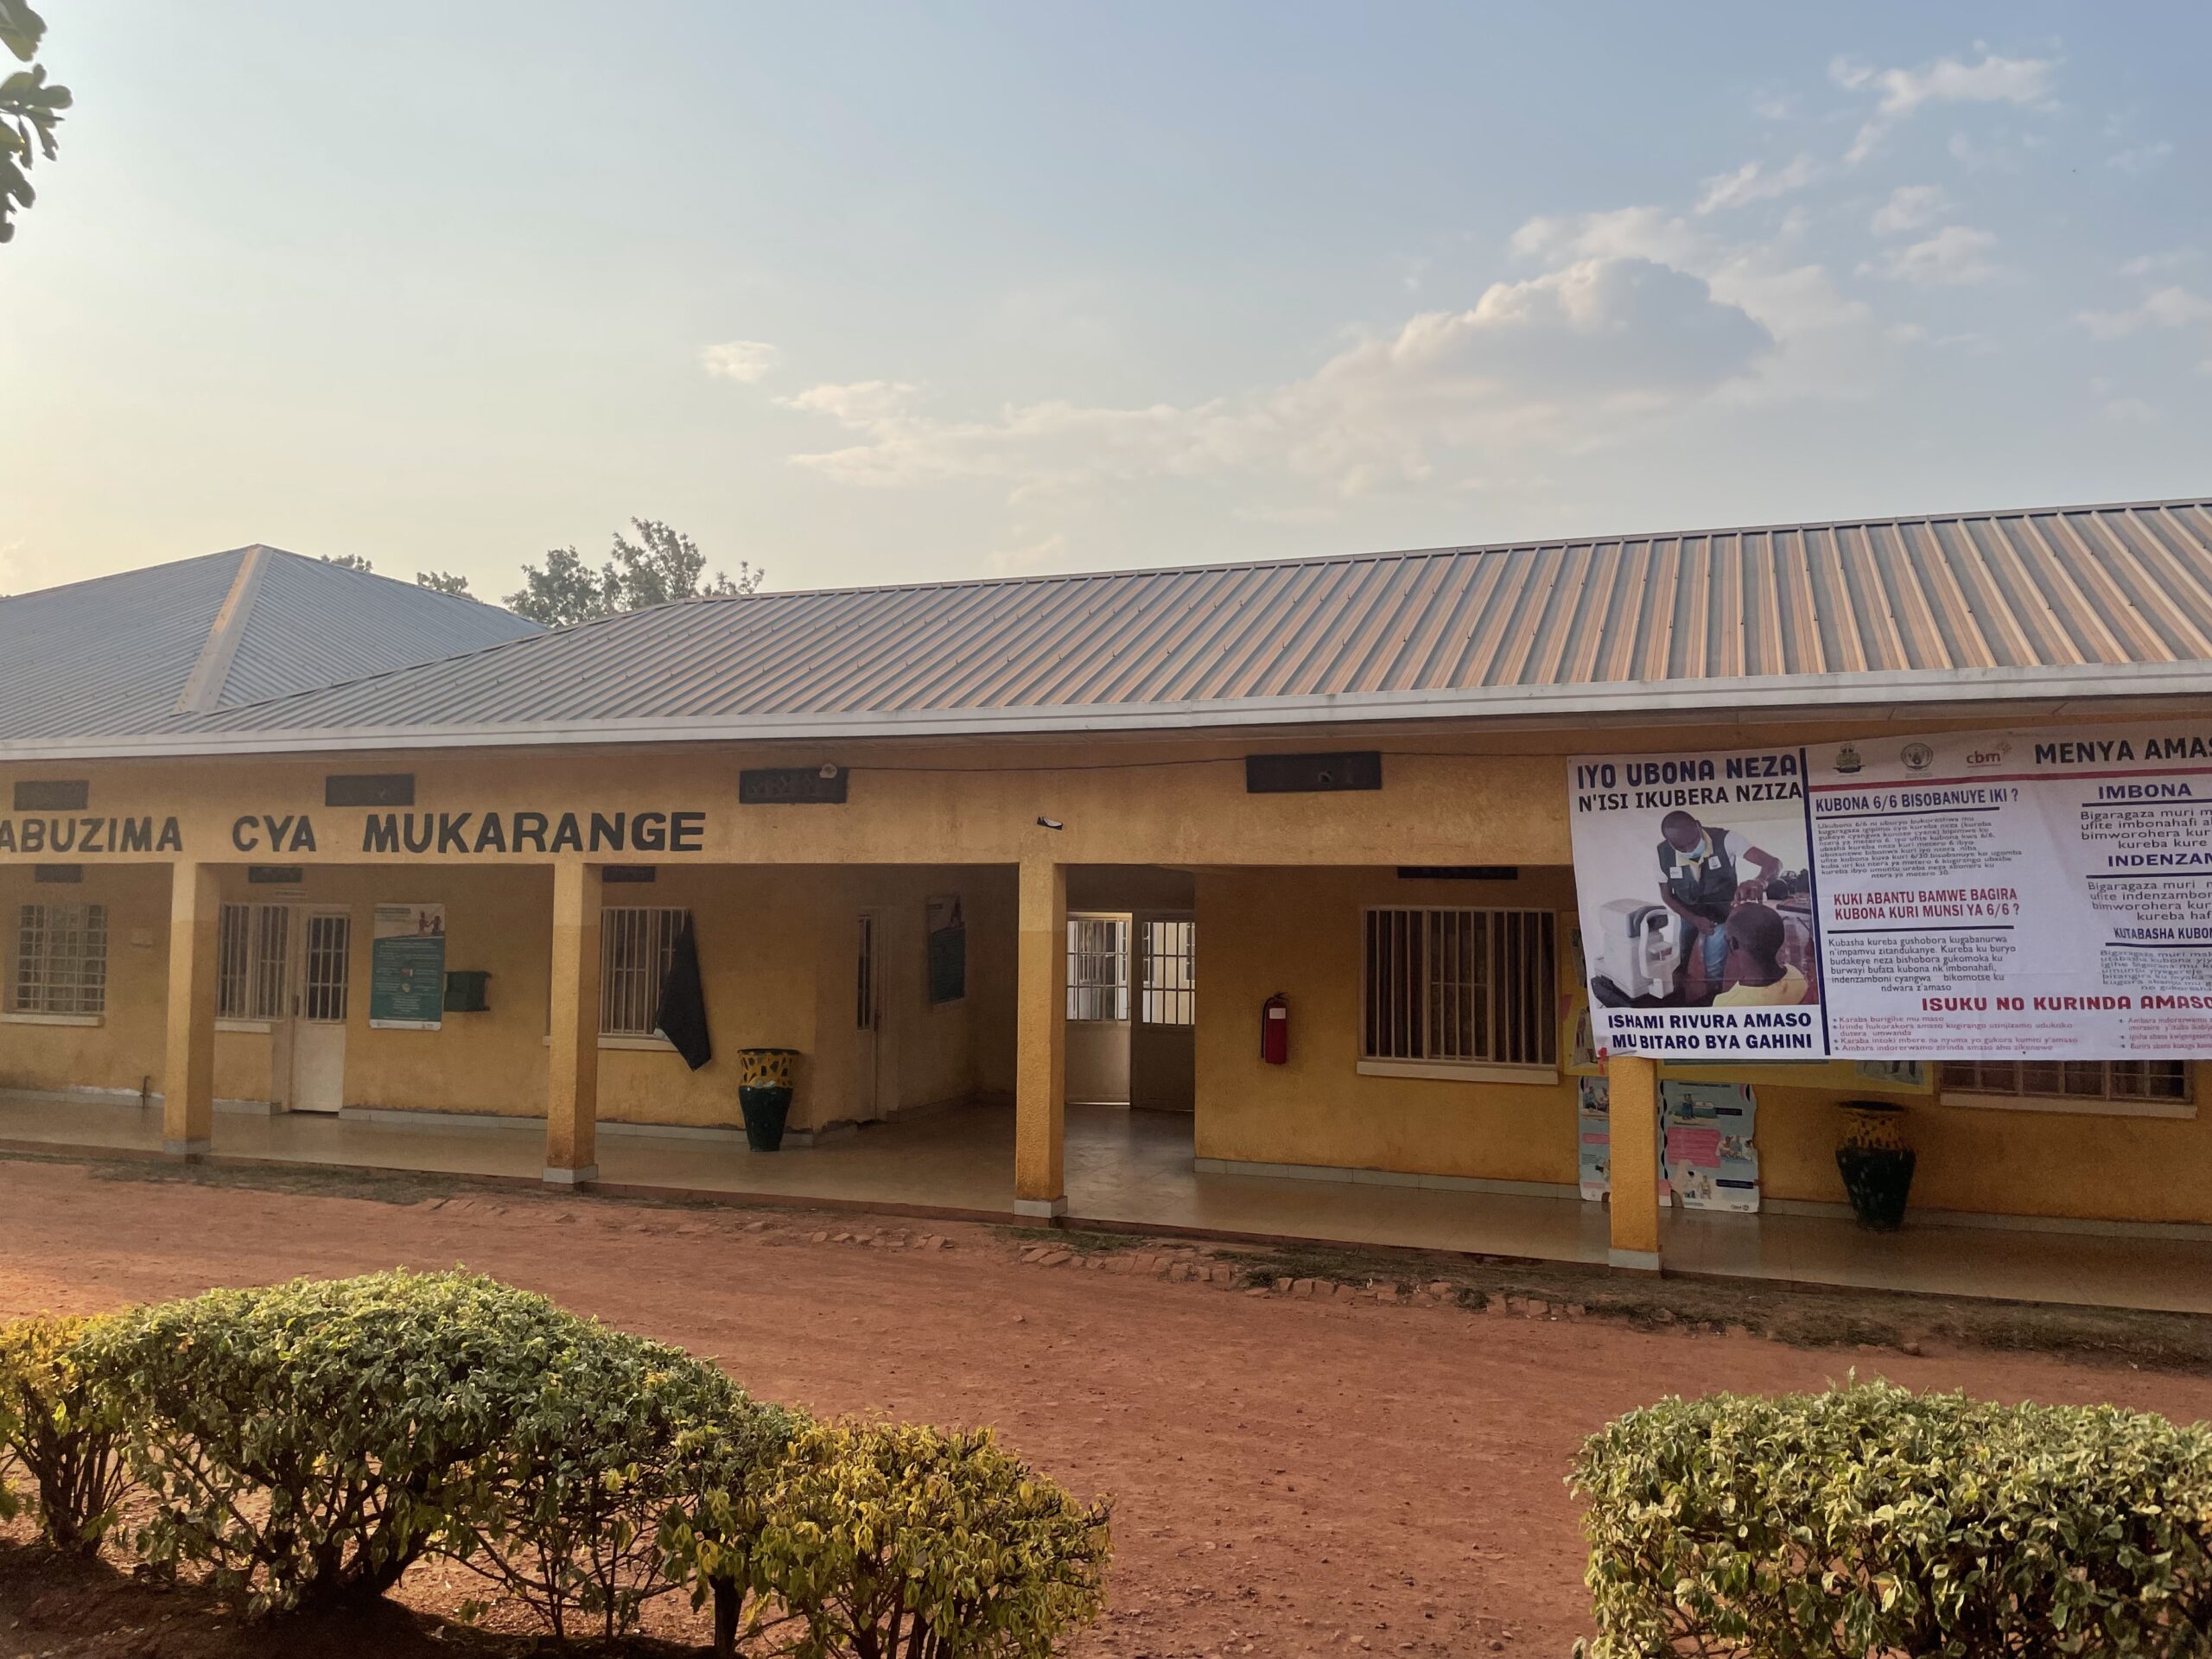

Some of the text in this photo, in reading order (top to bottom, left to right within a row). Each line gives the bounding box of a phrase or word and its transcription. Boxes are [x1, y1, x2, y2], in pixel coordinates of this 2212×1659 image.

[1967, 750, 2001, 764] cbm
[2035, 740, 2135, 765] MENYA
[1578, 754, 1796, 789] IYO UBONA NEZA
[1579, 782, 1802, 811] N'ISI IKUBERA NZIZA
[2098, 783, 2192, 799] IMBONA
[1816, 796, 1870, 812] KUBONA
[1873, 794, 1897, 811] 6/6
[1901, 790, 1986, 807] BISOBANUYE
[1989, 788, 2007, 803] IKI
[2081, 810, 2154, 822] Bigaragaza
[2161, 808, 2194, 817] muri
[2081, 821, 2113, 830] ufite
[2118, 817, 2196, 829] imbonahafi
[0, 812, 706, 854] ABUZIMA CYA MUKARANGE
[2082, 830, 2180, 840] bimworohera
[2118, 838, 2207, 849] kureba kure
[2088, 881, 2158, 893] Bigaragaza
[1834, 888, 2018, 906] KUKI ABANTU BAMWE BAGIRA
[1835, 906, 1885, 920] KUBONA
[1890, 906, 1918, 918] KURI
[1923, 905, 1963, 917] MUNSI
[1967, 904, 1983, 916] YA
[1986, 903, 2009, 918] 6/6
[2092, 901, 2182, 911] bimworohera
[2137, 912, 2185, 921] kureba
[2113, 926, 2175, 940] KUTABASHA
[1828, 938, 1864, 947] Kubasha
[1900, 936, 1946, 947] gushobora
[1949, 936, 2007, 945] kugabanurwa
[1990, 944, 2016, 954] buryo
[1830, 957, 1871, 967] budakeye
[1896, 955, 1940, 963] bishobora
[1943, 954, 1989, 965] gukomoka
[1831, 966, 1865, 976] burwayi
[1868, 965, 1894, 974] bufata
[1897, 964, 1929, 973] kubona
[1832, 975, 1891, 983] indenzamboni
[1894, 976, 1931, 984] cyangwa
[1922, 997, 1987, 1012] ISUKU
[1997, 997, 2024, 1011] NO
[2033, 996, 2132, 1011] KURINDA
[1608, 1013, 1811, 1029] ISHAMI RIVURA AMASO
[1706, 1036, 1740, 1049] BYA
[1745, 1034, 1812, 1048] GAHINI
